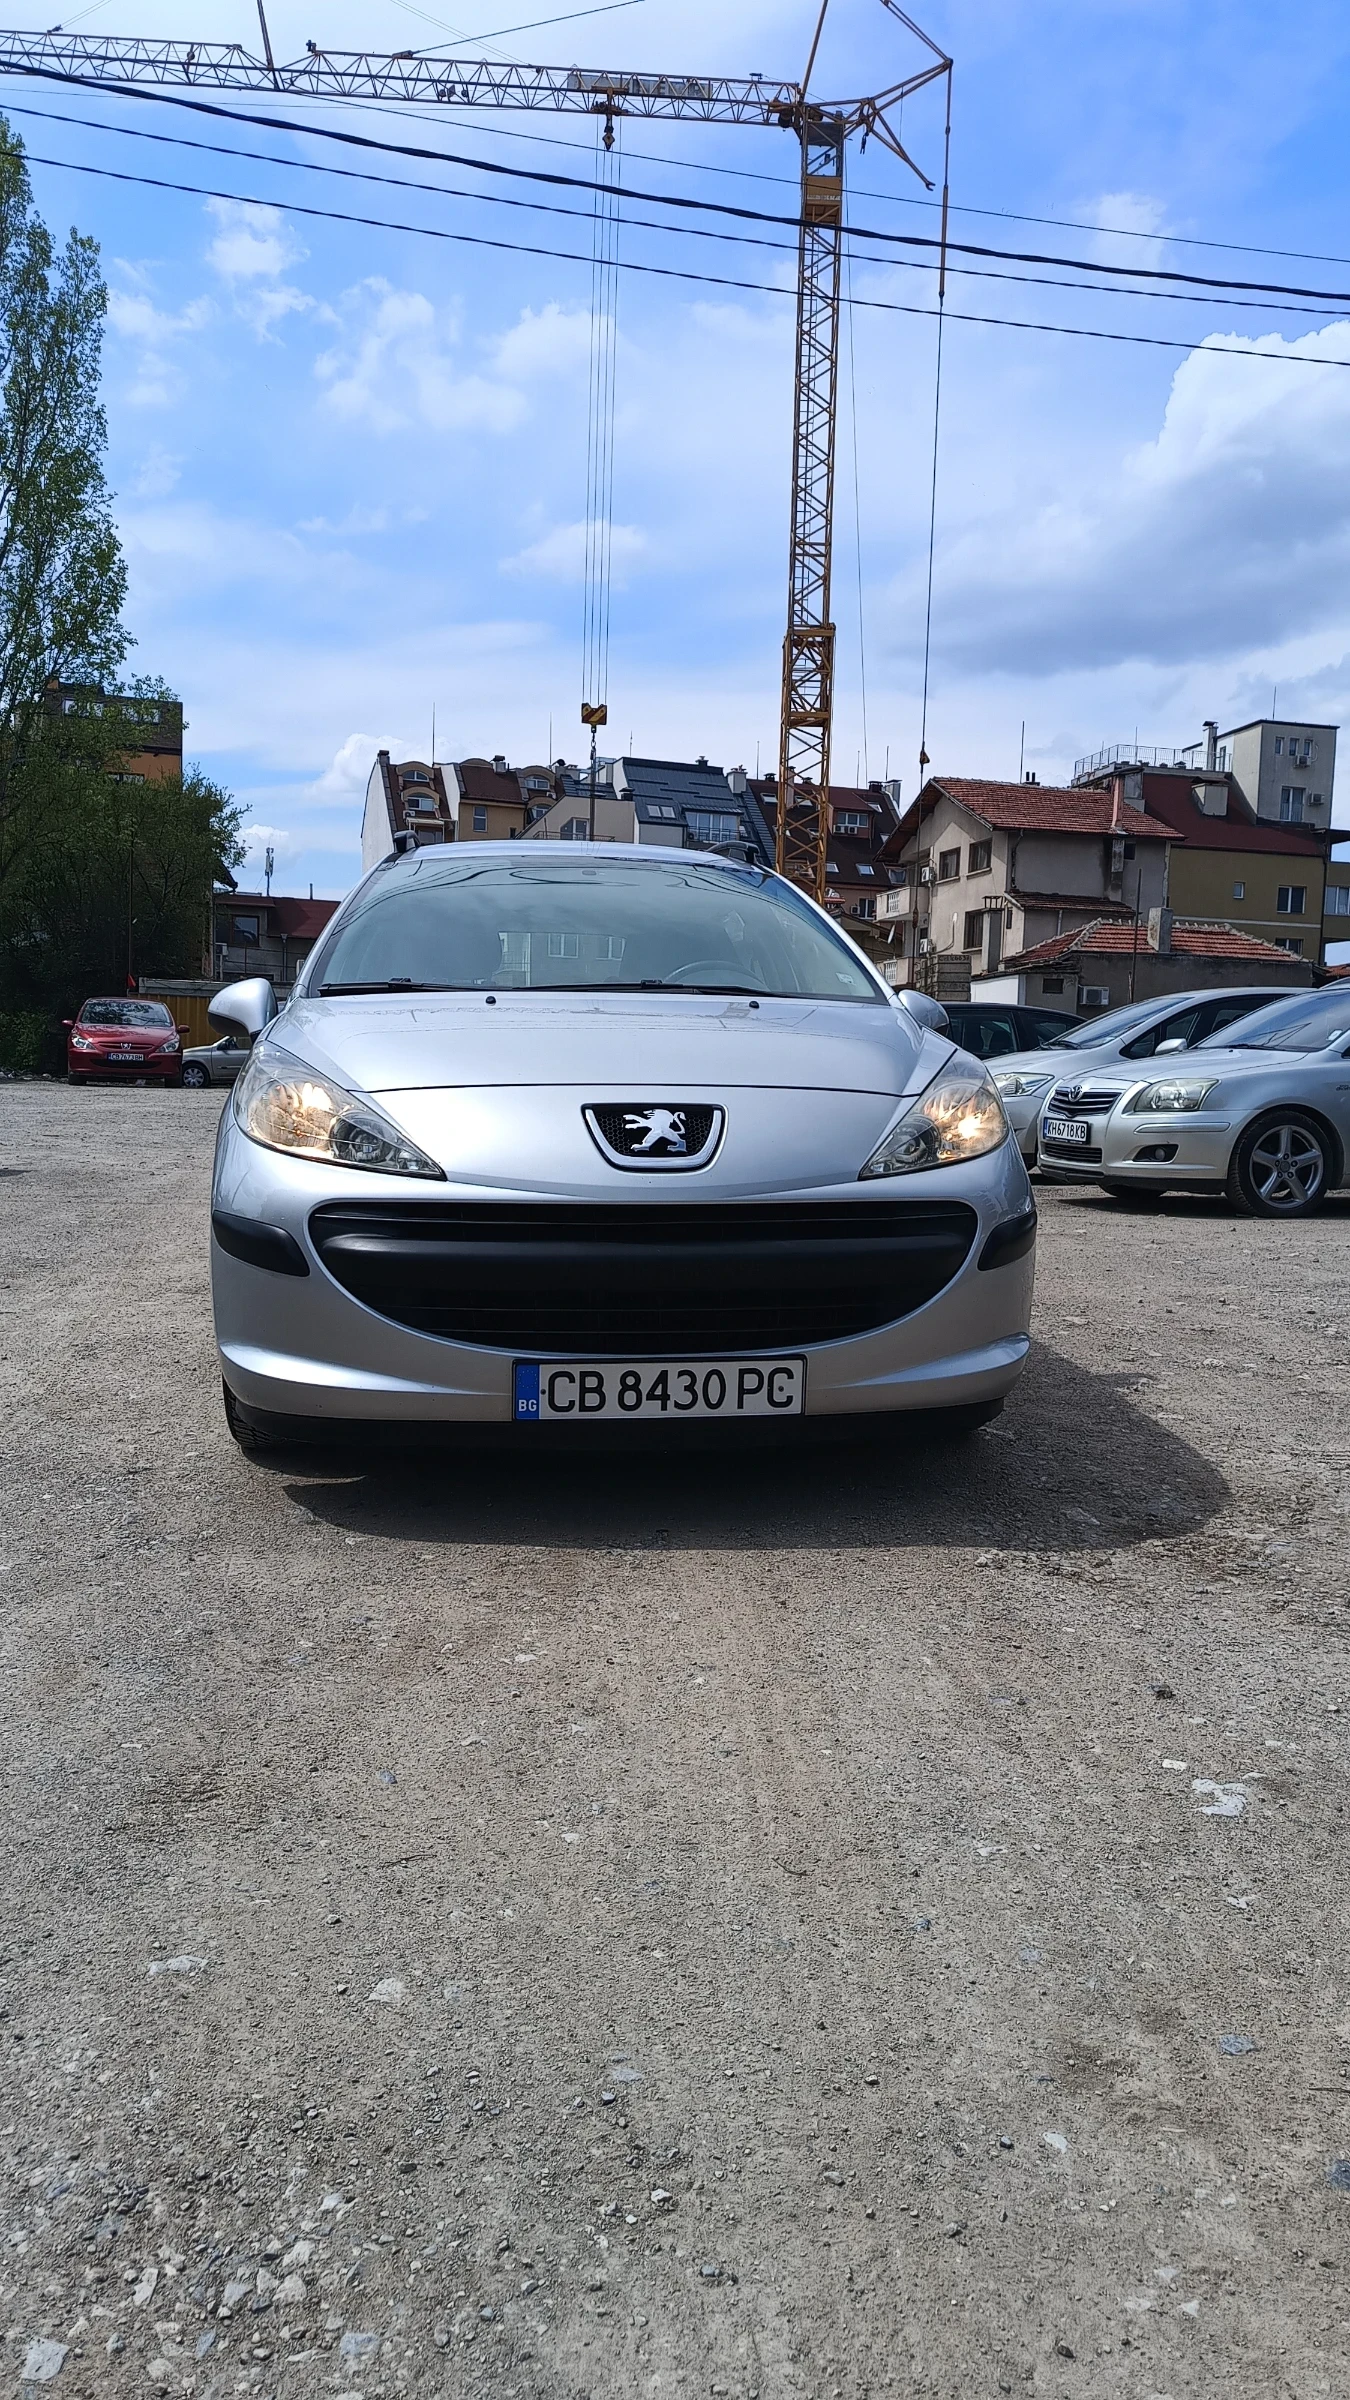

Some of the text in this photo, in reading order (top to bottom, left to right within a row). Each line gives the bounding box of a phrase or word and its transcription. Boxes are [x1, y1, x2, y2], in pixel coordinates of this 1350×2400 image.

[518, 1366, 795, 1413] BG CB 8430 PC
